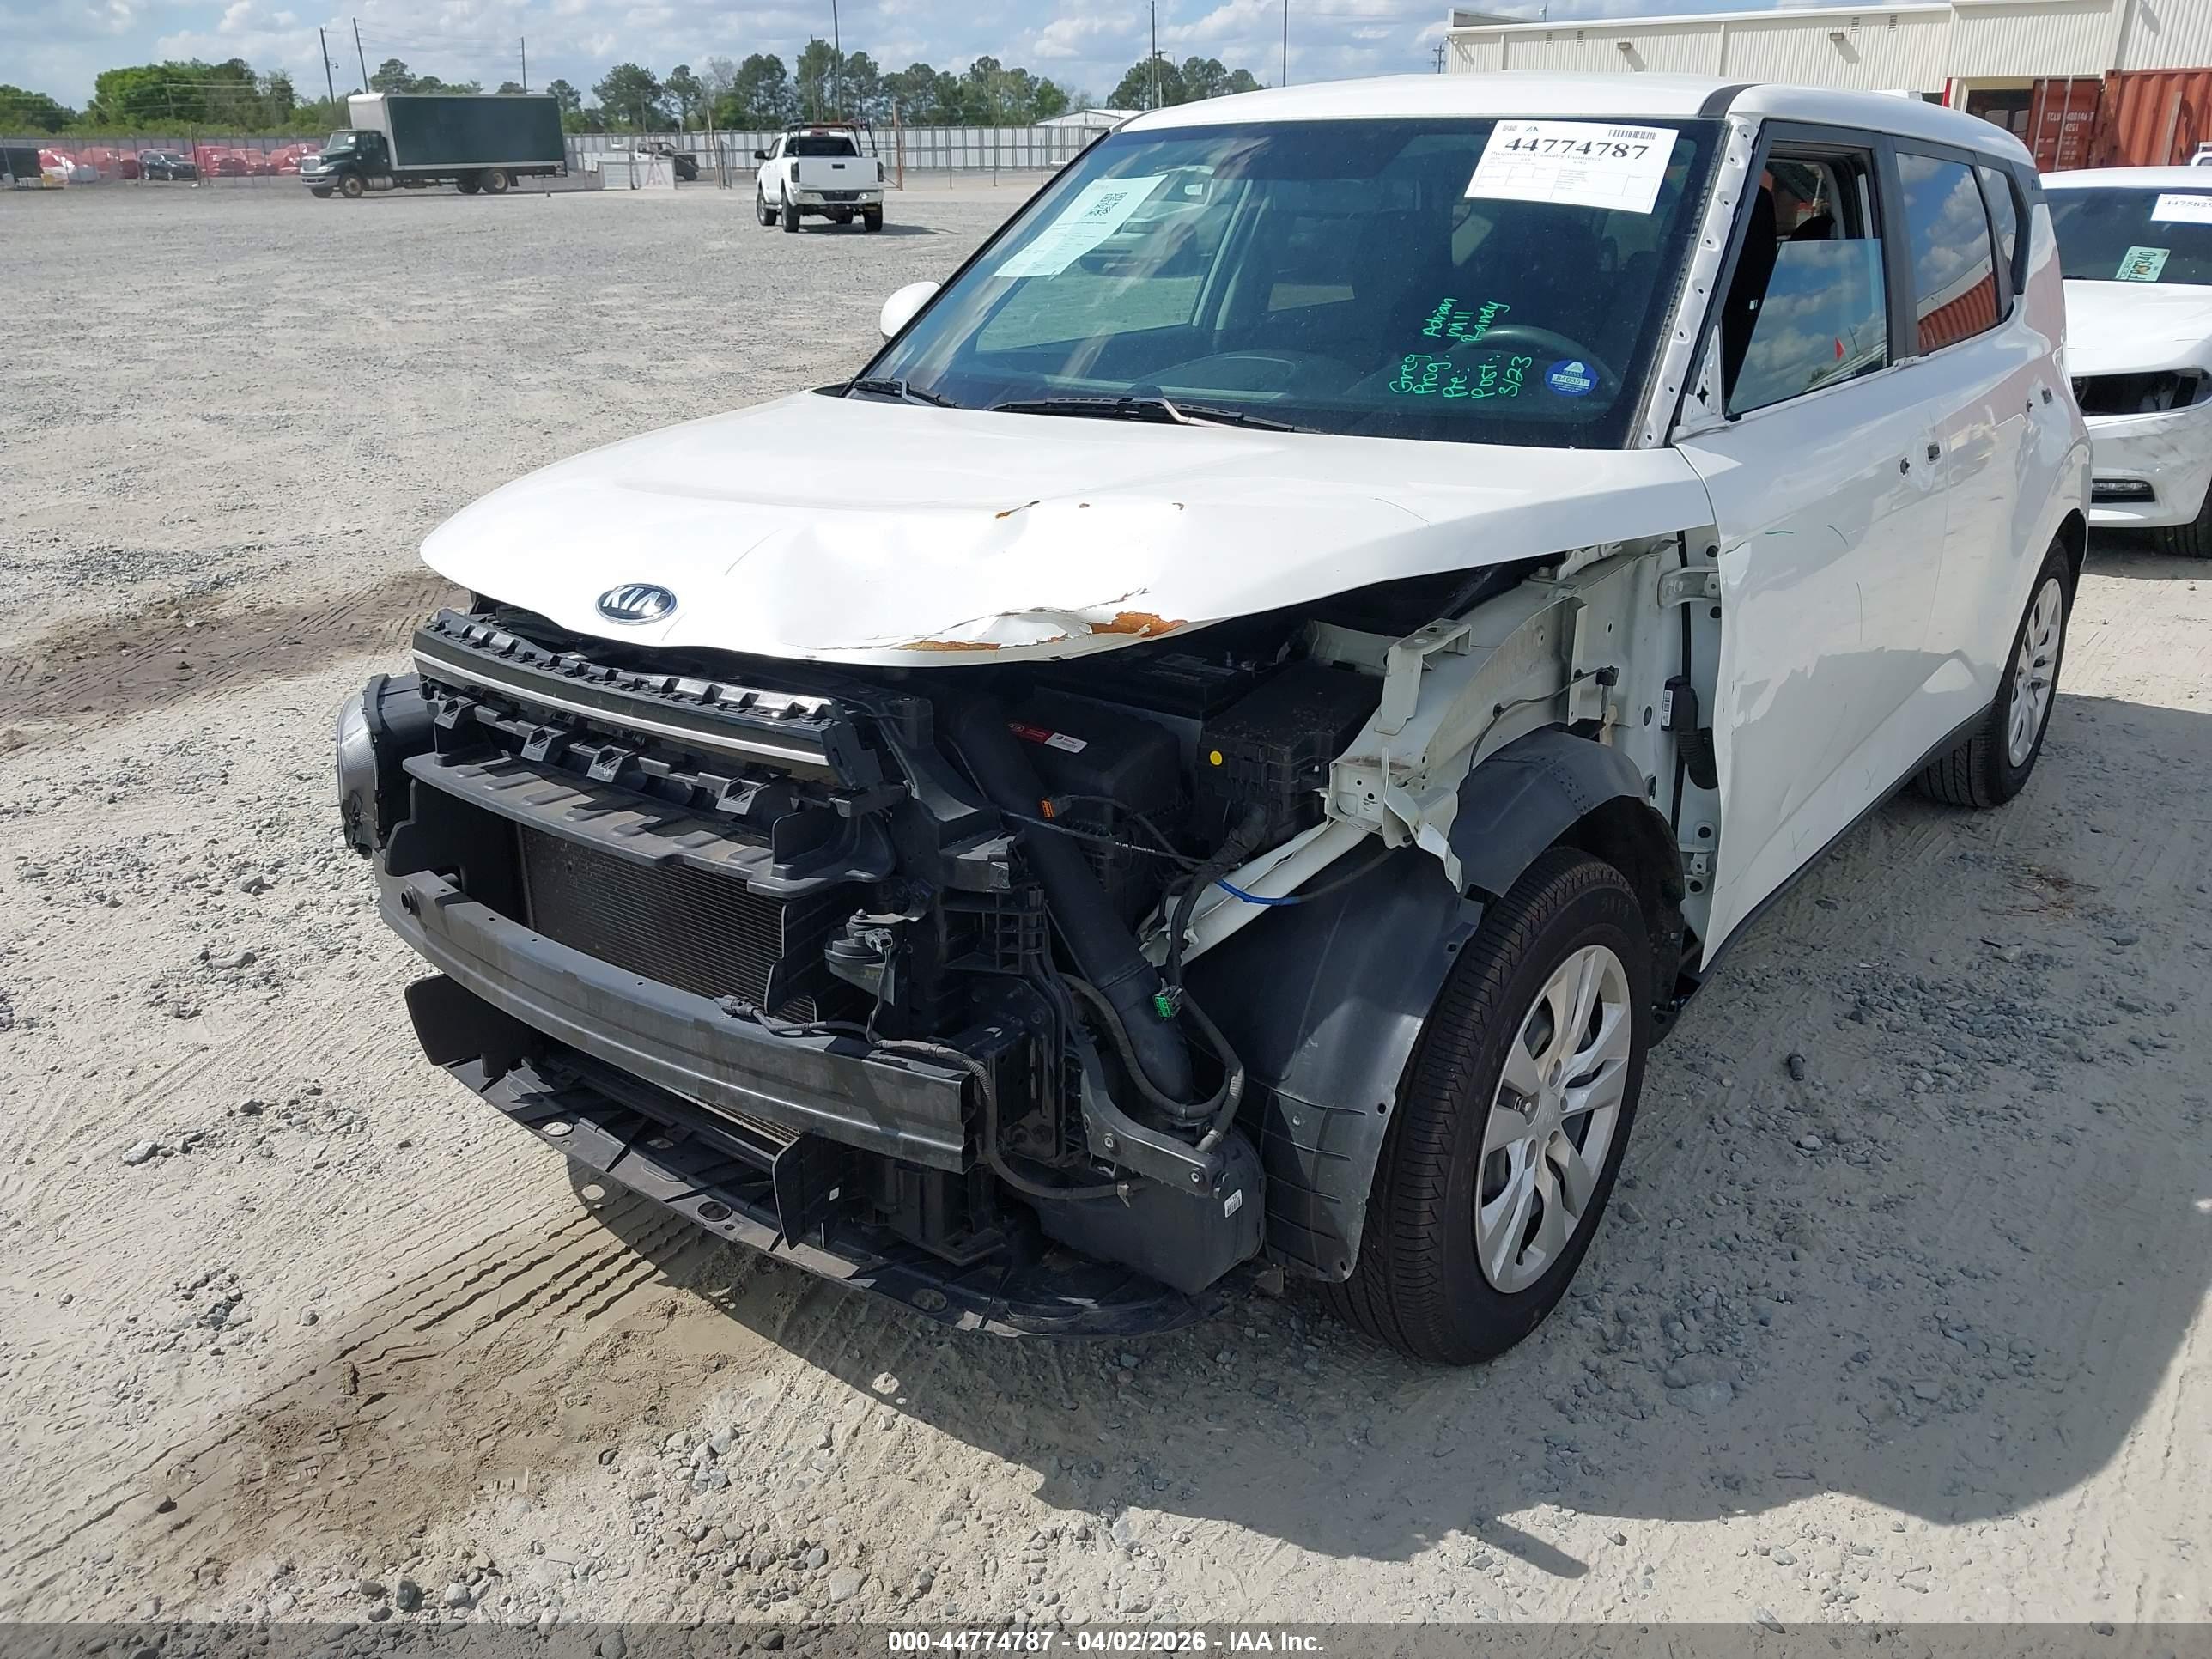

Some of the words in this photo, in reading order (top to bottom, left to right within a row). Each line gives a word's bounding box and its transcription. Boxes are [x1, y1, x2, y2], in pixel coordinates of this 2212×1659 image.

[1504, 137, 1650, 160] 44774787
[1422, 297, 1459, 337] Adrian
[1461, 301, 1511, 343] Randy
[1389, 353, 1433, 393] Greg
[1498, 356, 1533, 398] 3/23
[602, 586, 661, 615] KIA
